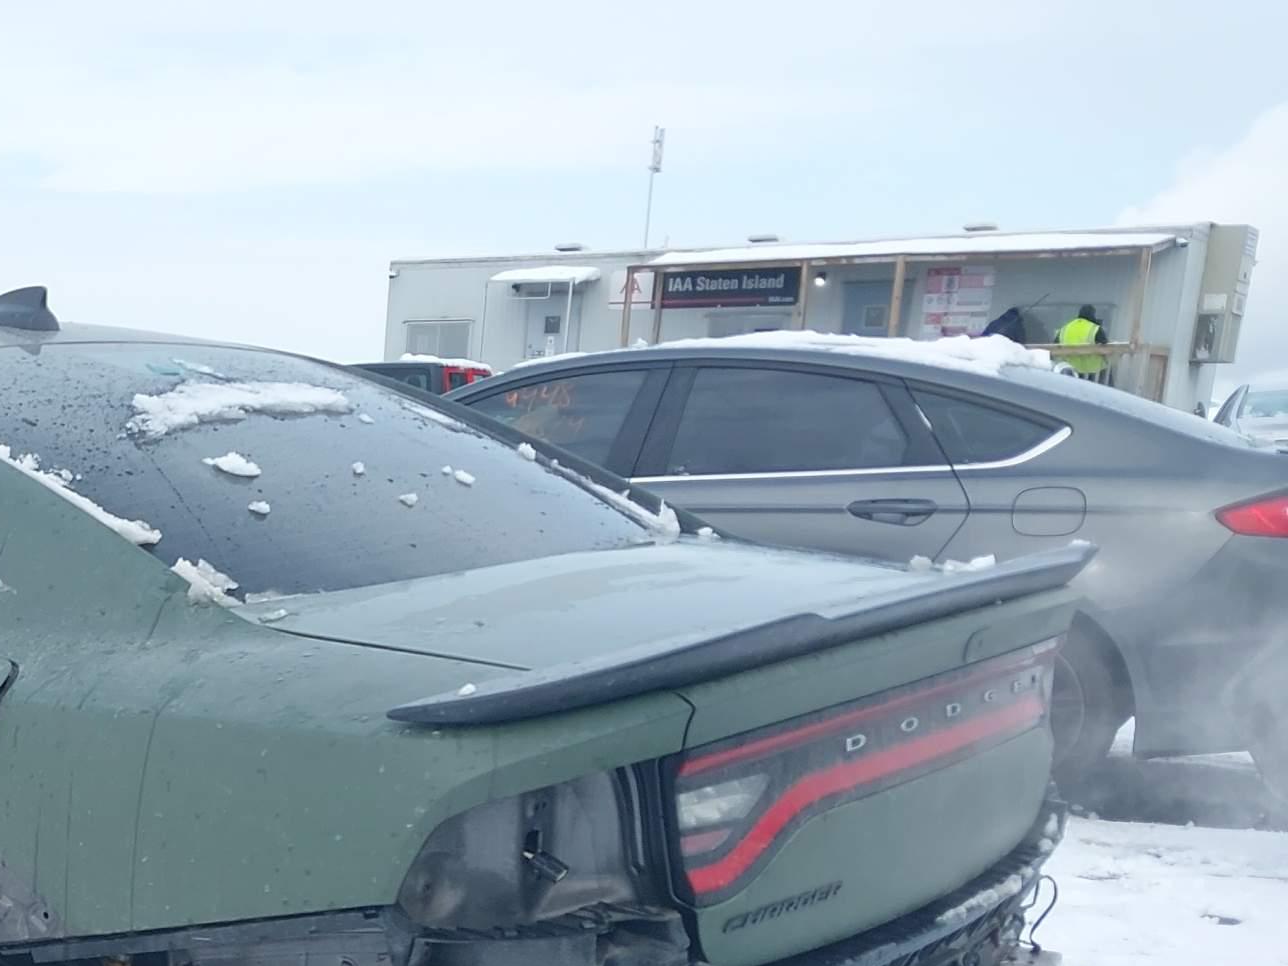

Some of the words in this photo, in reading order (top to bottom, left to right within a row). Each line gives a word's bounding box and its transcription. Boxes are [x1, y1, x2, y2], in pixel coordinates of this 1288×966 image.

[668, 277, 693, 292] IAA
[696, 275, 739, 291] Staten
[742, 273, 785, 289] Island
[846, 678, 1024, 752] DODGE
